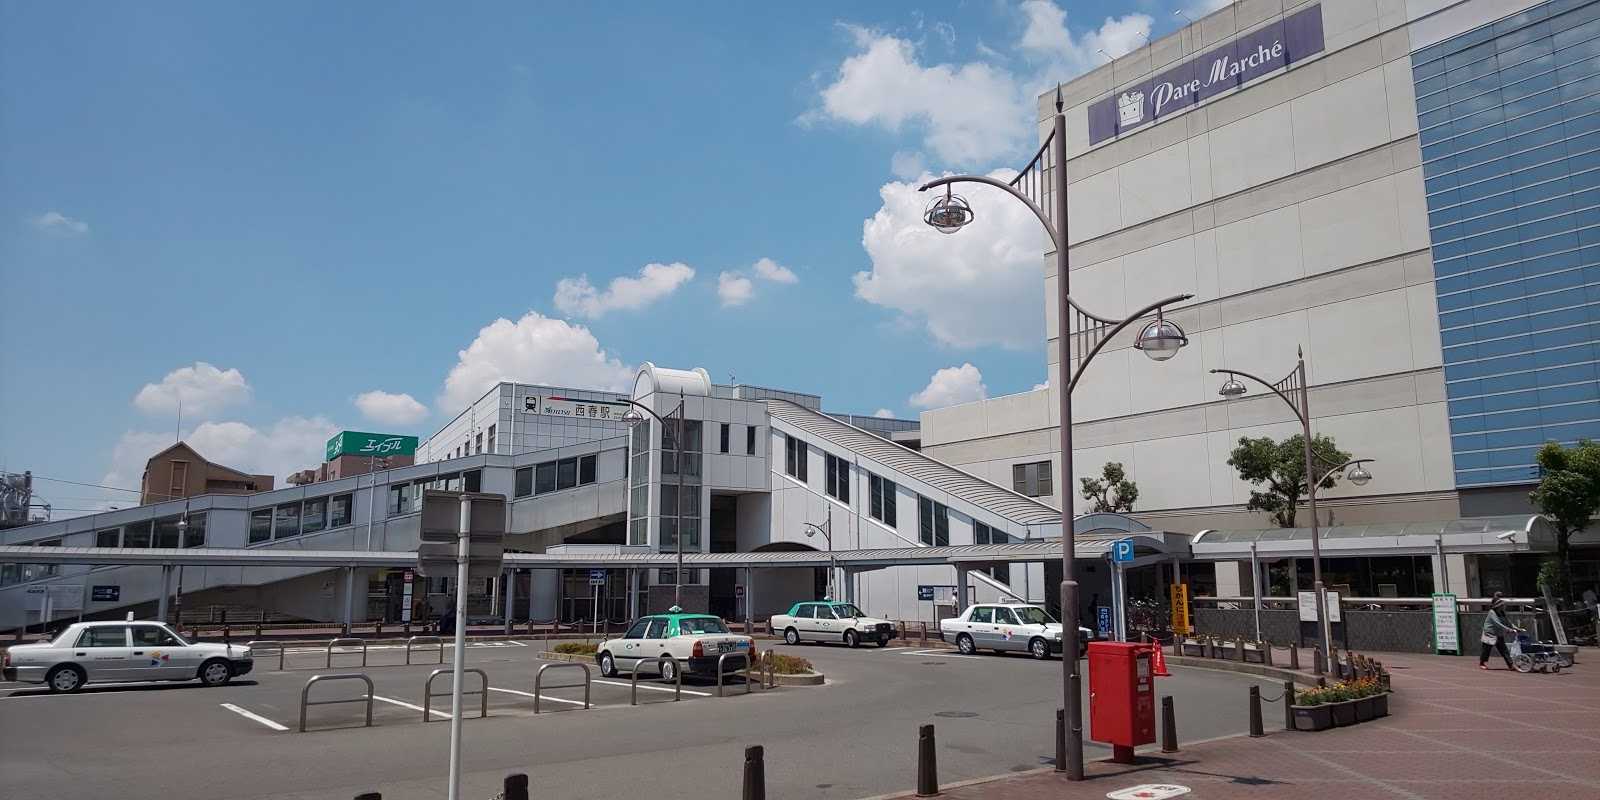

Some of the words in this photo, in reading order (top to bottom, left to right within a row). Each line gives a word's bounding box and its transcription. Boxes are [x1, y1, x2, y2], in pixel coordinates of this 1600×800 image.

[1150, 80, 1201, 116] Pare
[1203, 40, 1283, 88] Marché
[575, 404, 610, 419] 西春駅
[359, 437, 404, 453] エイブル
[1118, 542, 1130, 560] P
